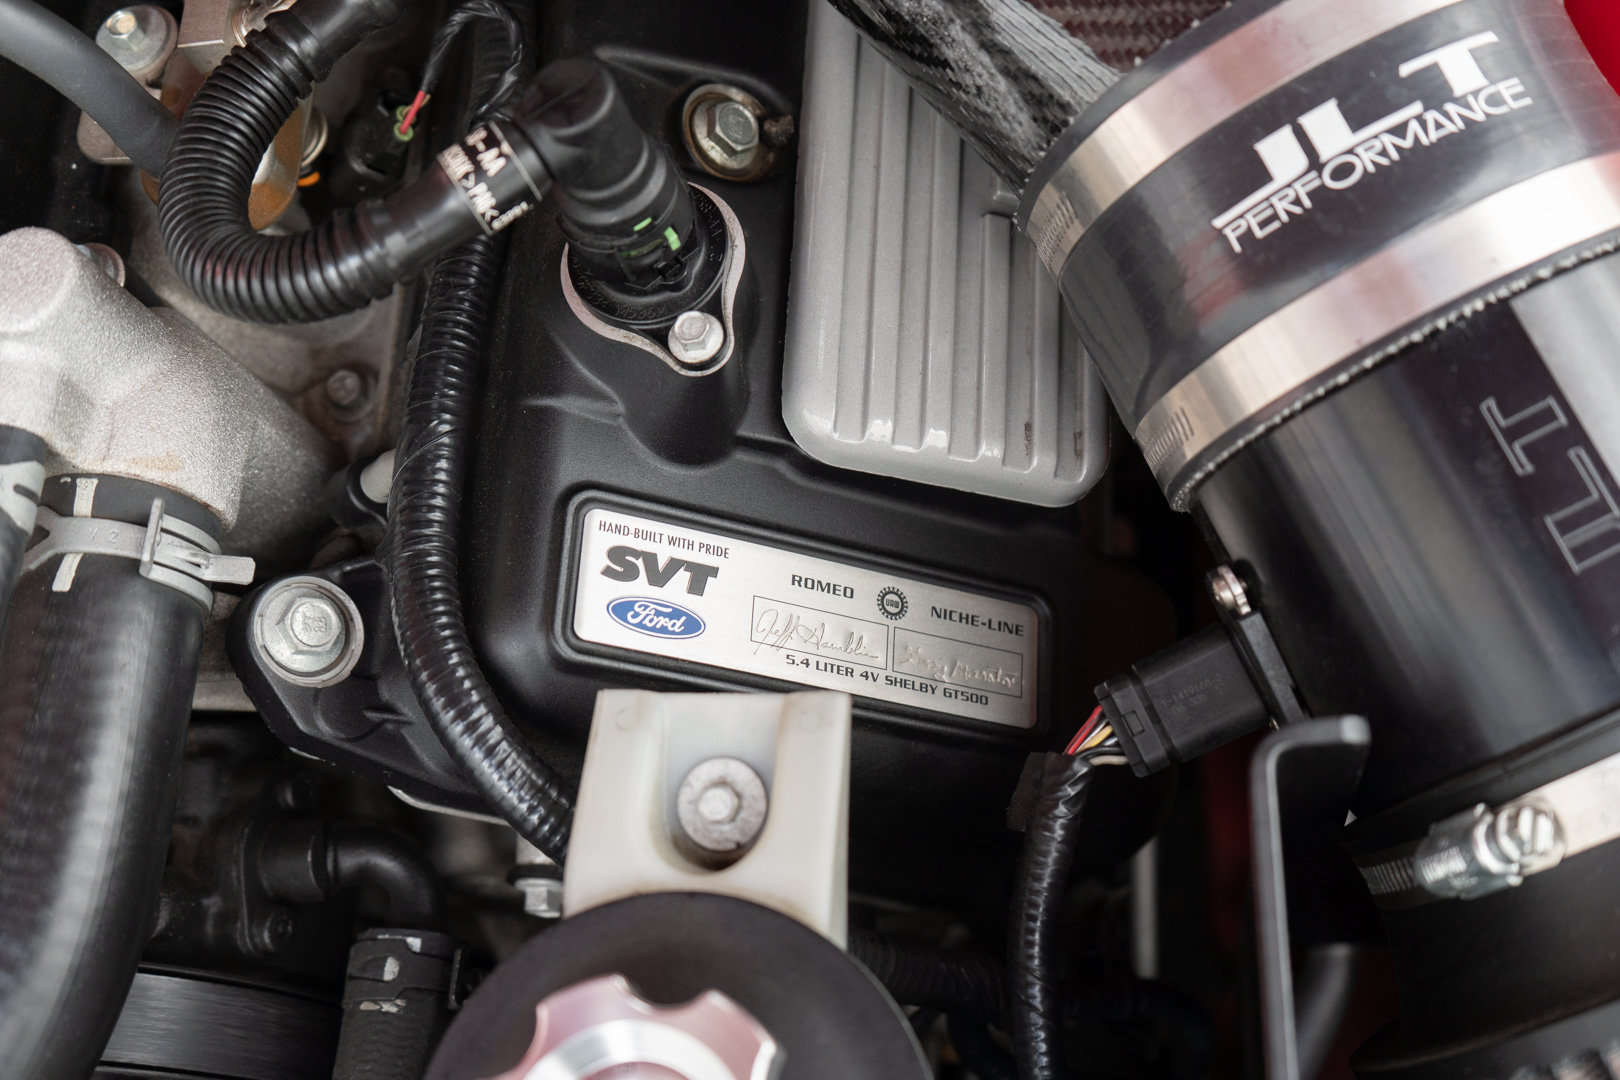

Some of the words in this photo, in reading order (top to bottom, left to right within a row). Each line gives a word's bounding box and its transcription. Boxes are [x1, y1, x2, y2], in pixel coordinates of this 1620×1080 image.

[1211, 29, 1500, 230] JLT
[1222, 76, 1534, 254] PERFORMANCE
[598, 519, 665, 545] HAND-BUILT
[667, 534, 695, 552] WITH
[698, 541, 730, 559] PRIDE
[599, 544, 720, 597] SVT
[791, 573, 855, 599] ROMEO
[626, 601, 687, 633] Ford
[885, 598, 900, 609] UAW
[930, 605, 1025, 637] NICHE-LINE
[785, 653, 811, 669] 5.4
[815, 659, 856, 678] LITER
[859, 670, 880, 683] 4V
[884, 674, 938, 695] SHELBY
[943, 687, 989, 706] GT500
